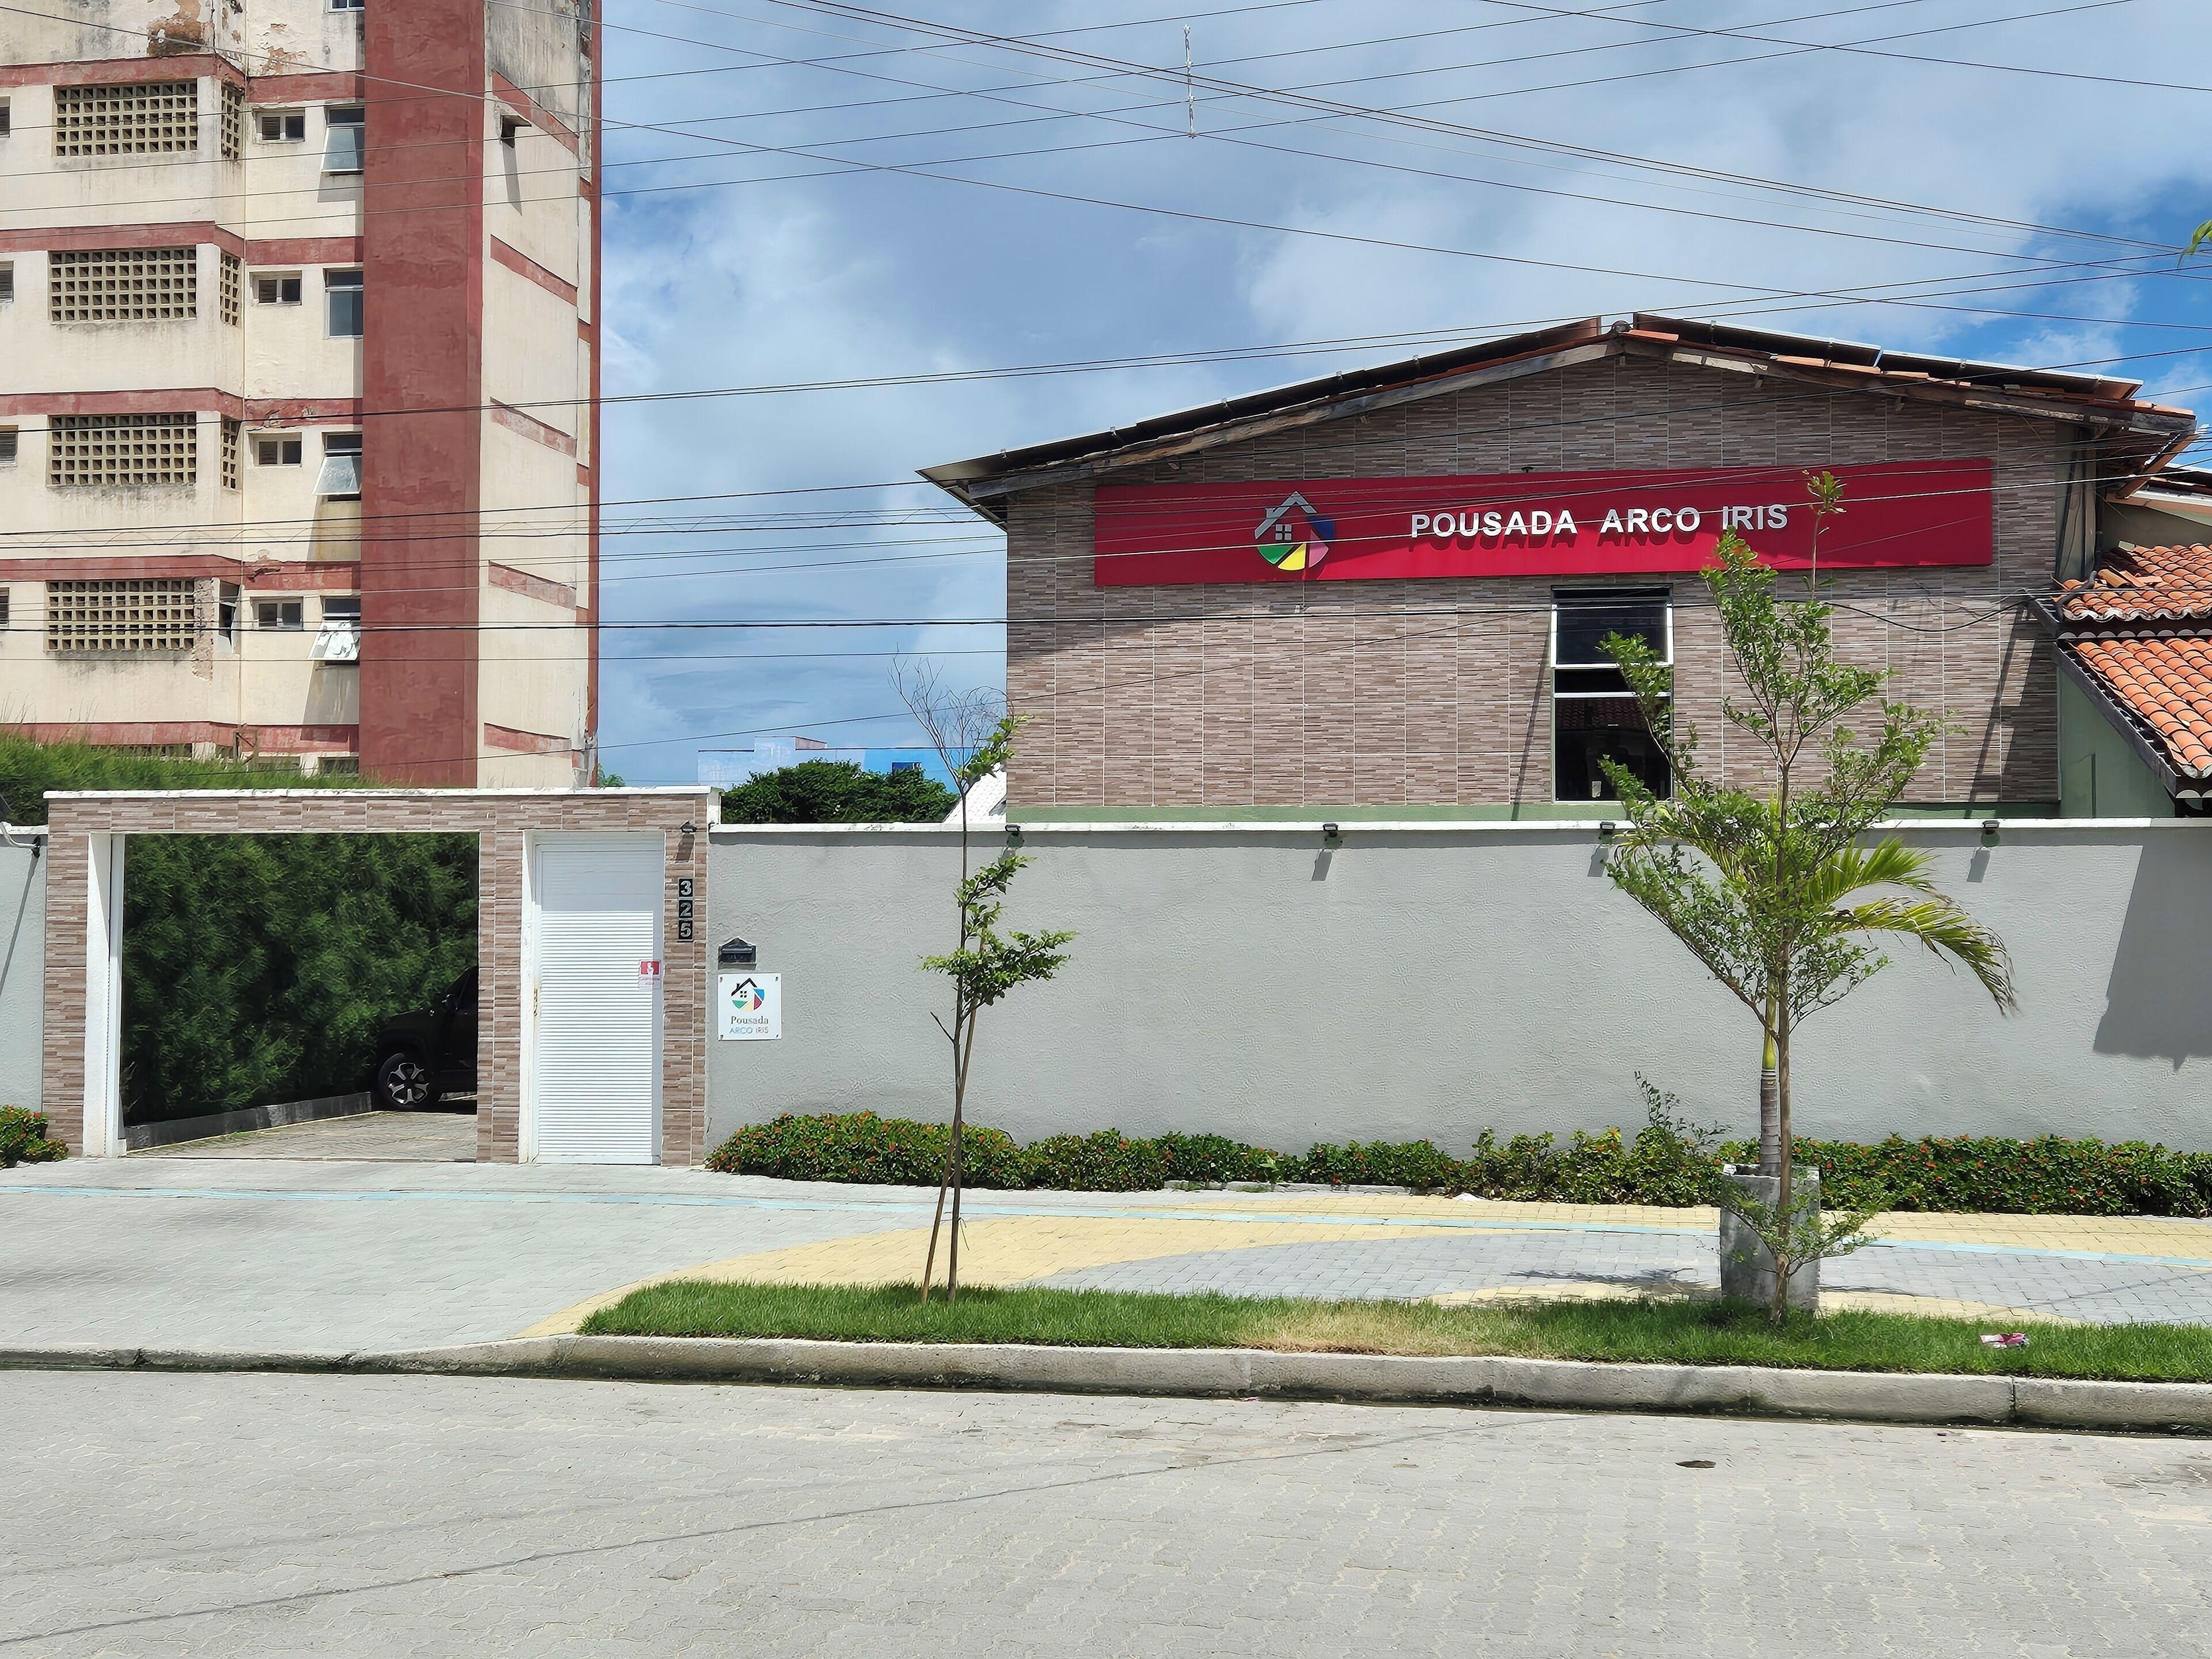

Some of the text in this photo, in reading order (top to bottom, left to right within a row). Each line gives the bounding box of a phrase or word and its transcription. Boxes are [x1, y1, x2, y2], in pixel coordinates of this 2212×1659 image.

[1411, 504, 1788, 537] POUSADA ARCO IRIS
[730, 1016, 769, 1024] Pousada
